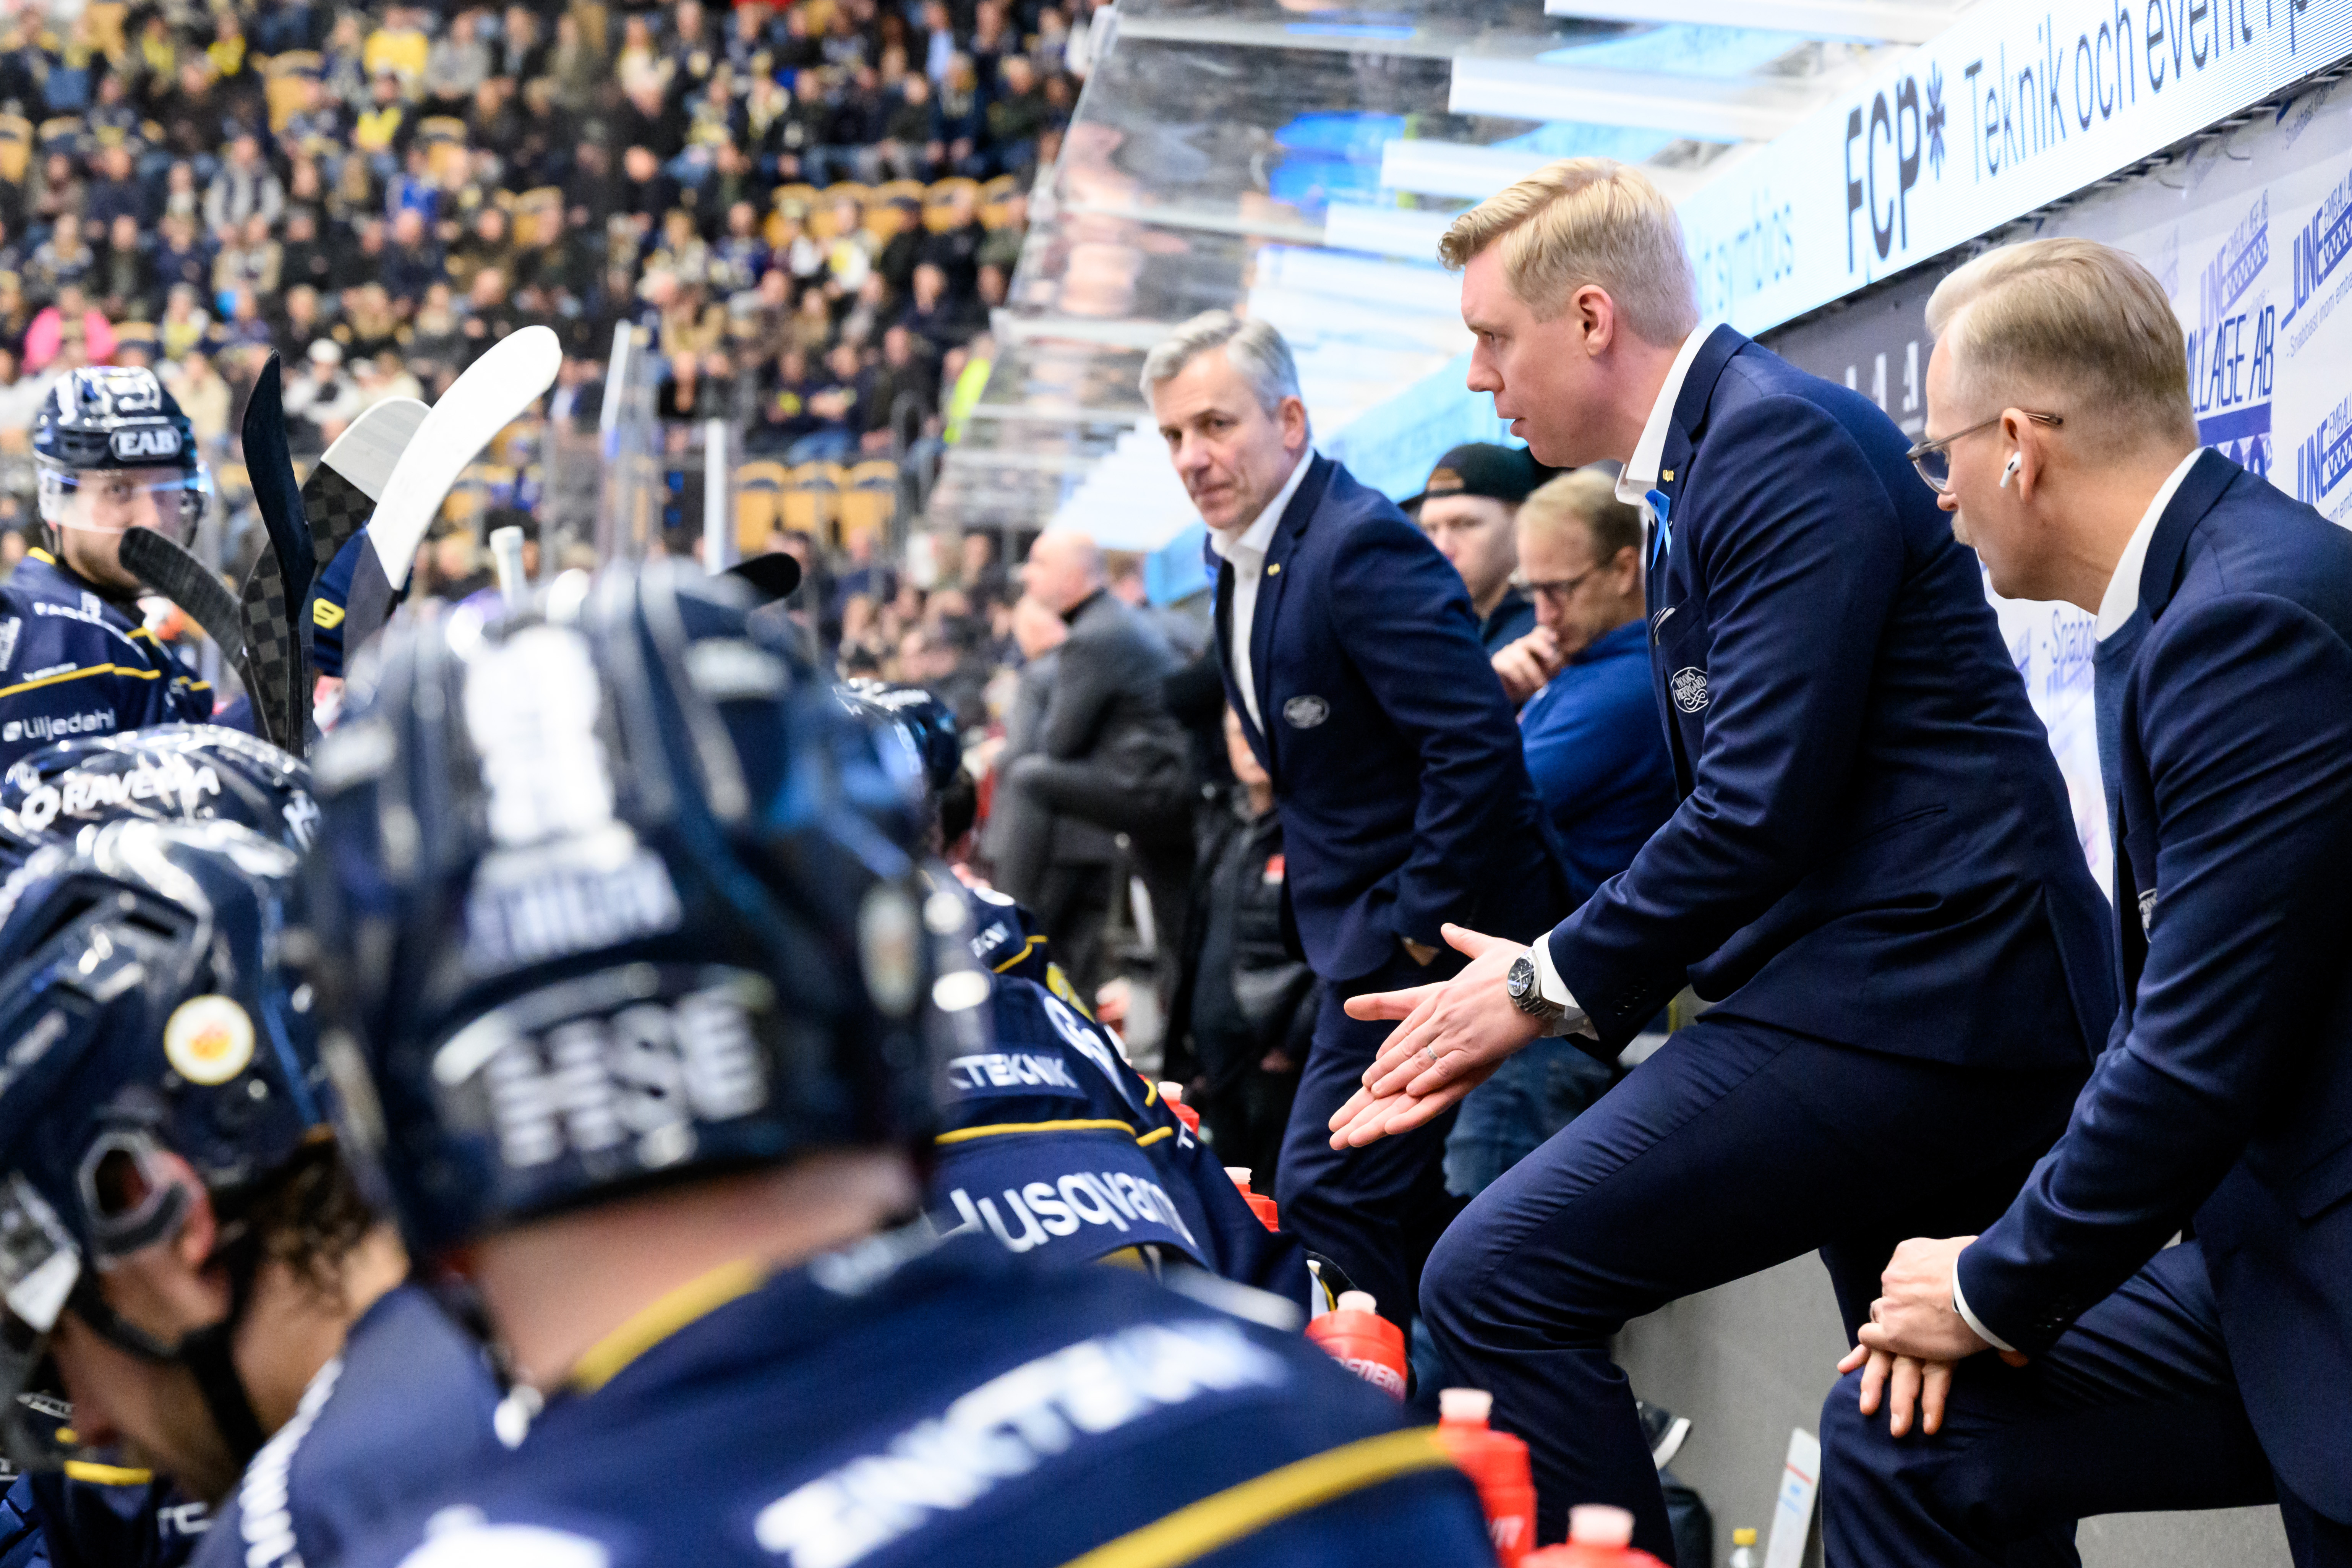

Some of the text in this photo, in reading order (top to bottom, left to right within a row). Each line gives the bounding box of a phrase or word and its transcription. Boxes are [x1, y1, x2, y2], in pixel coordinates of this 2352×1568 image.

[1965, 13, 2067, 184] Teknik
[2076, 0, 2136, 132] och
[2281, 205, 2324, 332] JUNE
[2248, 305, 2275, 402] AB
[117, 430, 178, 456] EAB
[22, 707, 115, 741] Liljedahl
